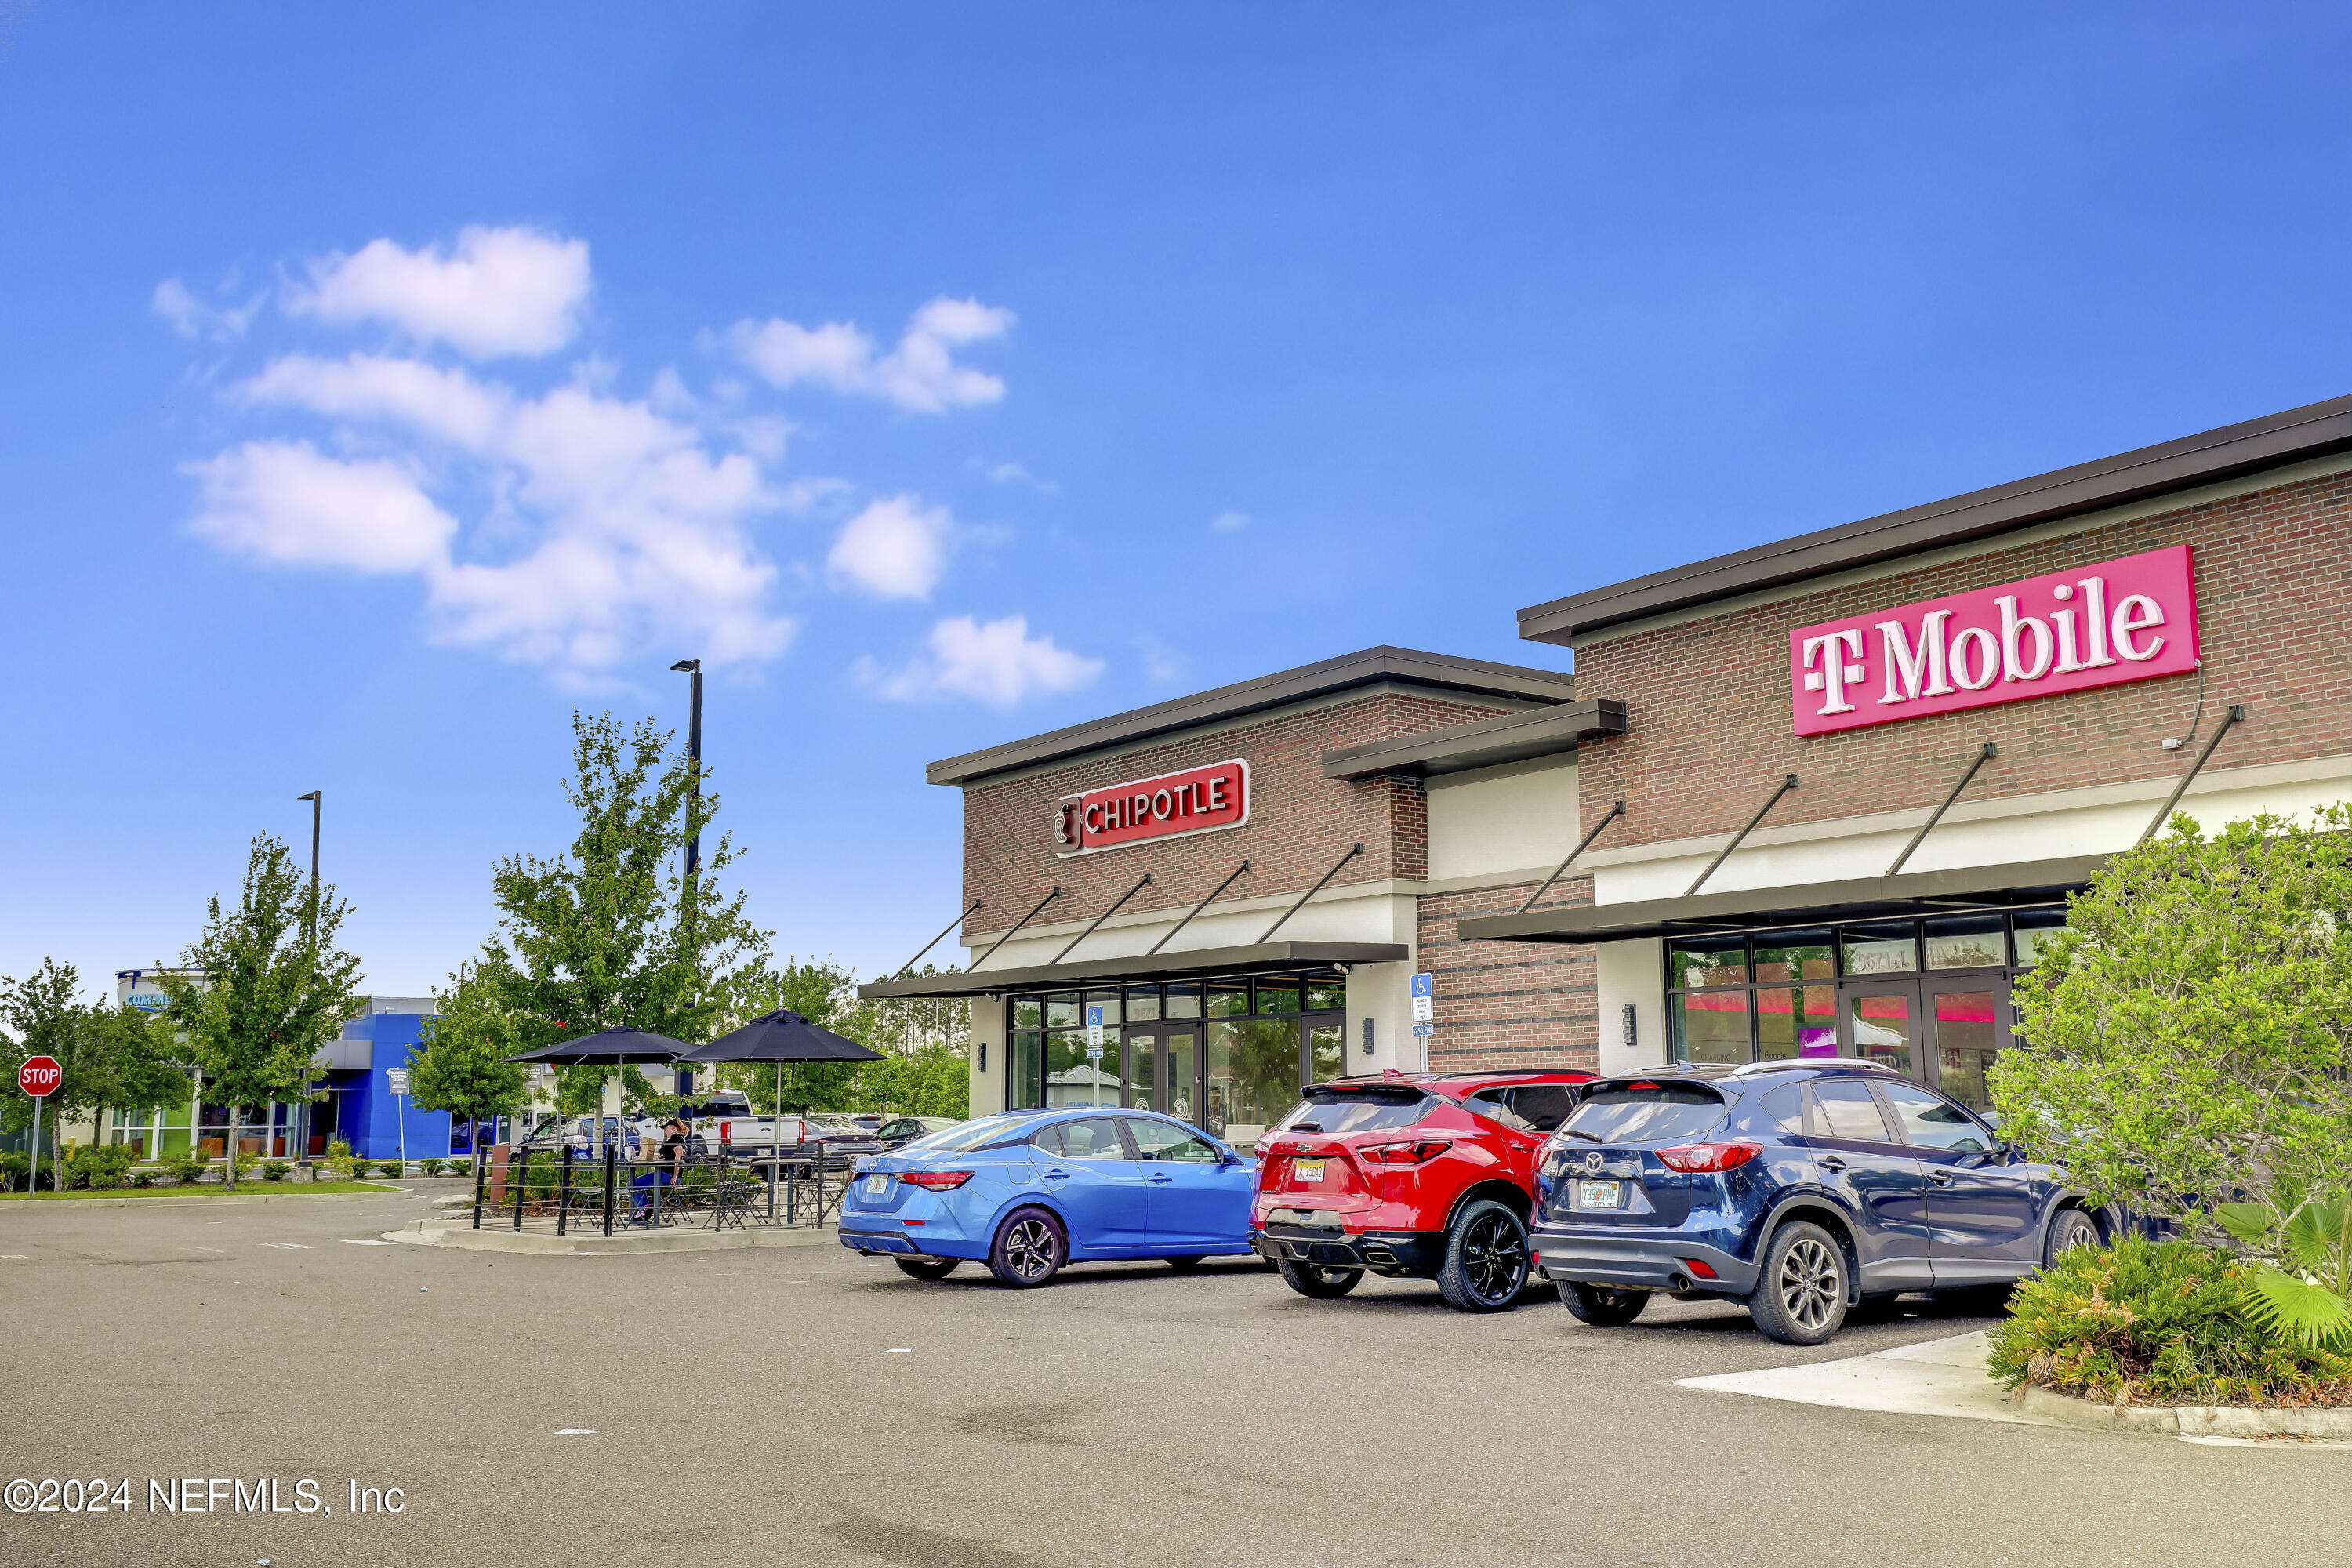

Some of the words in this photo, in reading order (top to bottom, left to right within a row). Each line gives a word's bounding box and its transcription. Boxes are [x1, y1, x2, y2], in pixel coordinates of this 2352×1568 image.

[1875, 576, 2165, 704] Mobile
[1085, 777, 1227, 833] CHIPOTLE
[1700, 1053, 1731, 1062] CHARGING
[1764, 1051, 1787, 1060] Google
[22, 1069, 59, 1083] STOP
